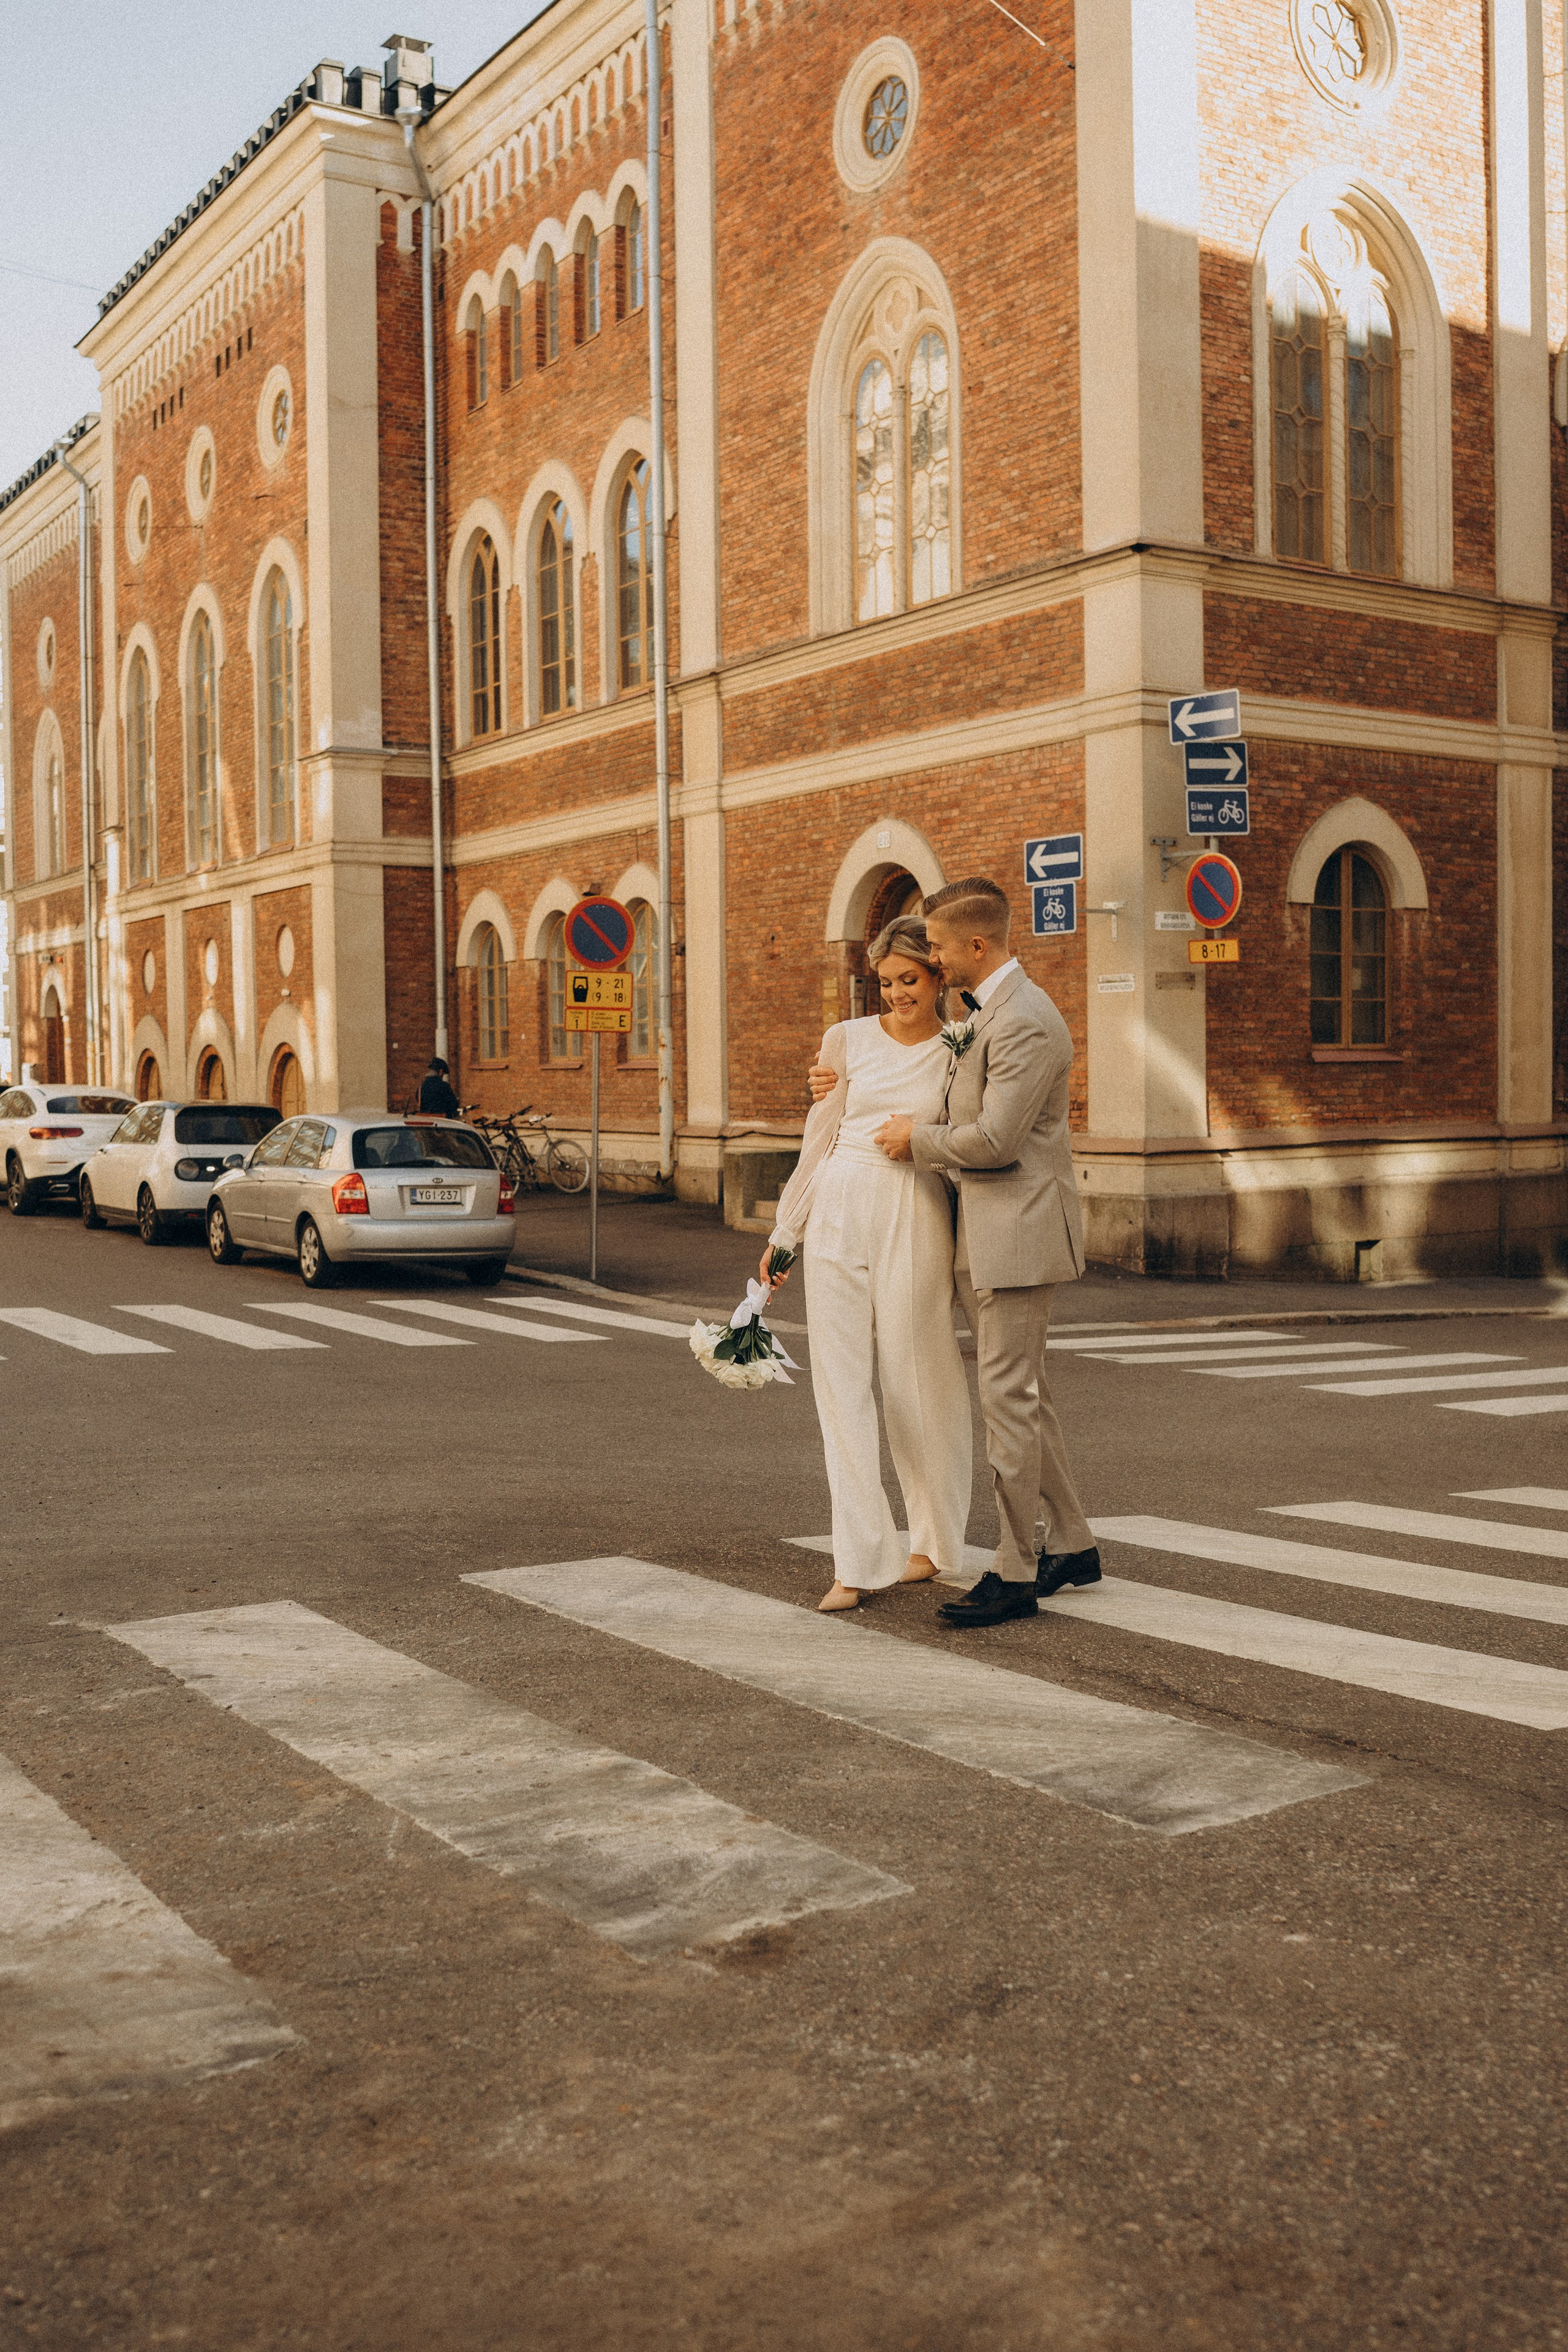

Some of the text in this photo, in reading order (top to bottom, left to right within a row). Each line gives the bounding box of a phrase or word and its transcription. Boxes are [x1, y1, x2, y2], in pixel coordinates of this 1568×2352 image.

[614, 978, 624, 989] 21
[575, 1019, 578, 1028] 1
[619, 1015, 625, 1027] E
[419, 1190, 458, 1200] YGI-237
